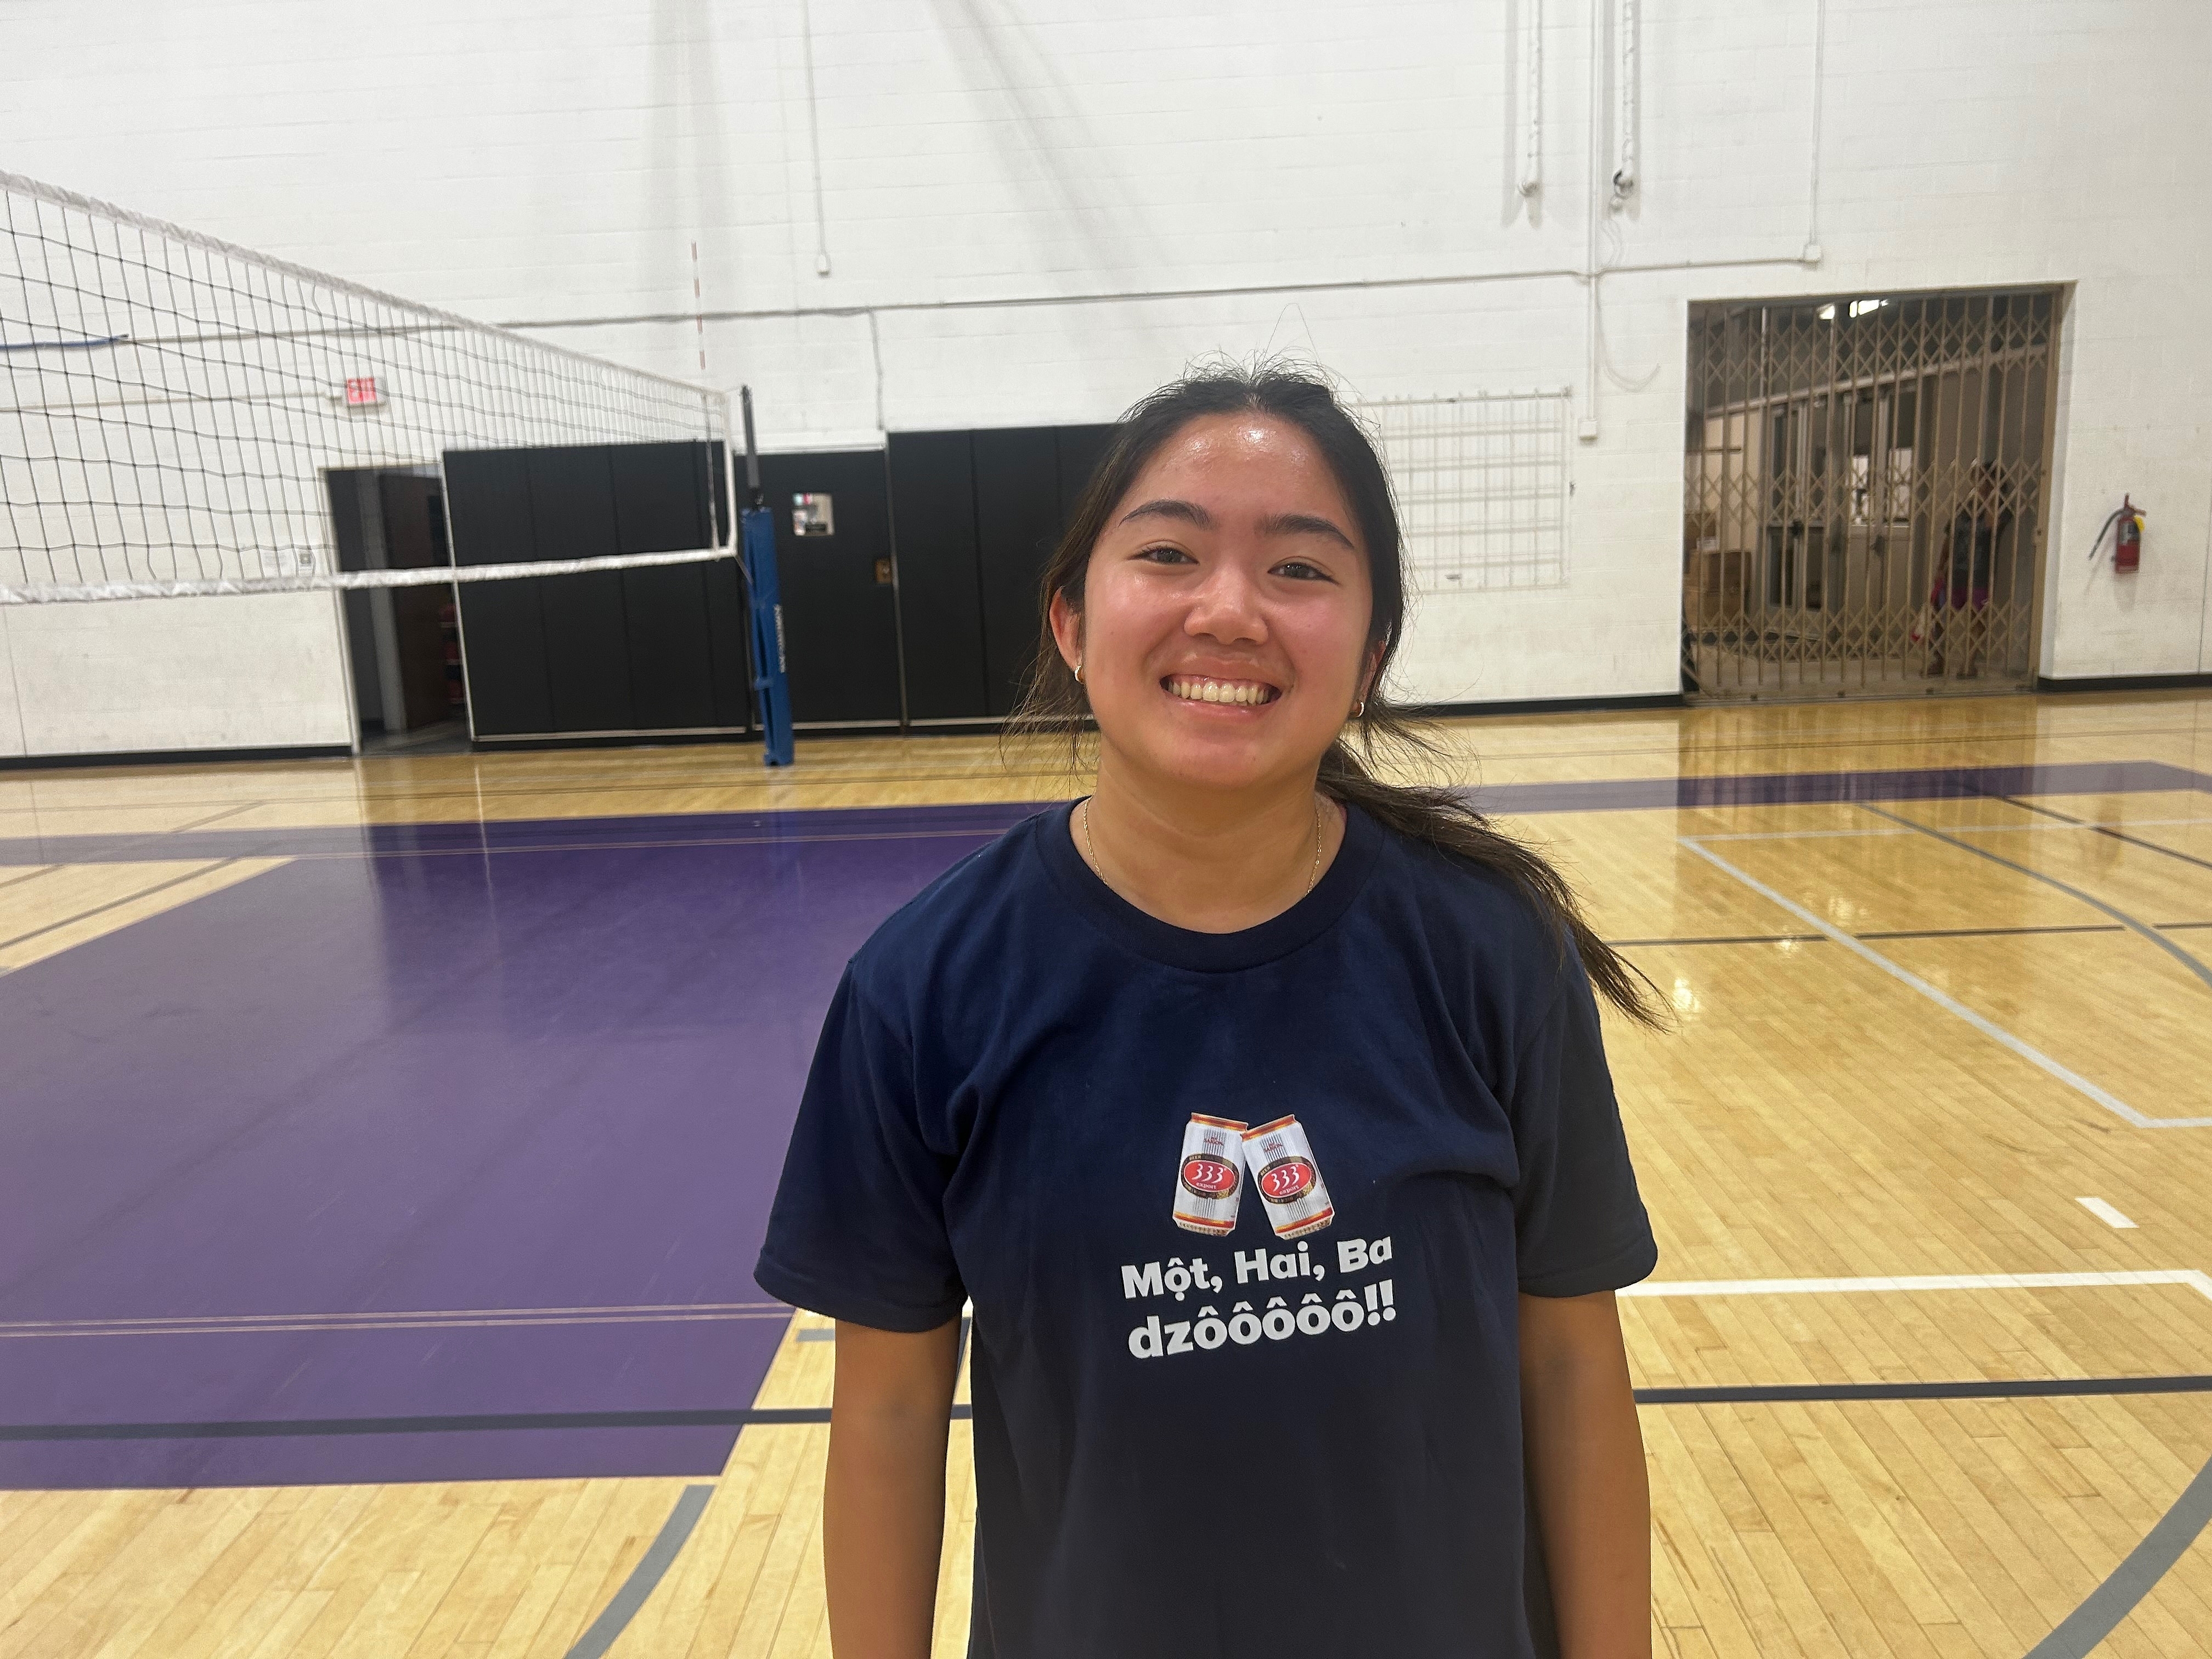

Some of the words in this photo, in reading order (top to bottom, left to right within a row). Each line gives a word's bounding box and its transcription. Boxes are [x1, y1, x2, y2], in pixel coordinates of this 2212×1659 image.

[1191, 1163, 1224, 1183] 333
[1271, 1165, 1300, 1192] 333
[1121, 1257, 1223, 1301] Một,
[1234, 1240, 1325, 1284] Hai,
[1337, 1235, 1392, 1273] Ba
[1128, 1279, 1397, 1359] dzôôôôô!!
